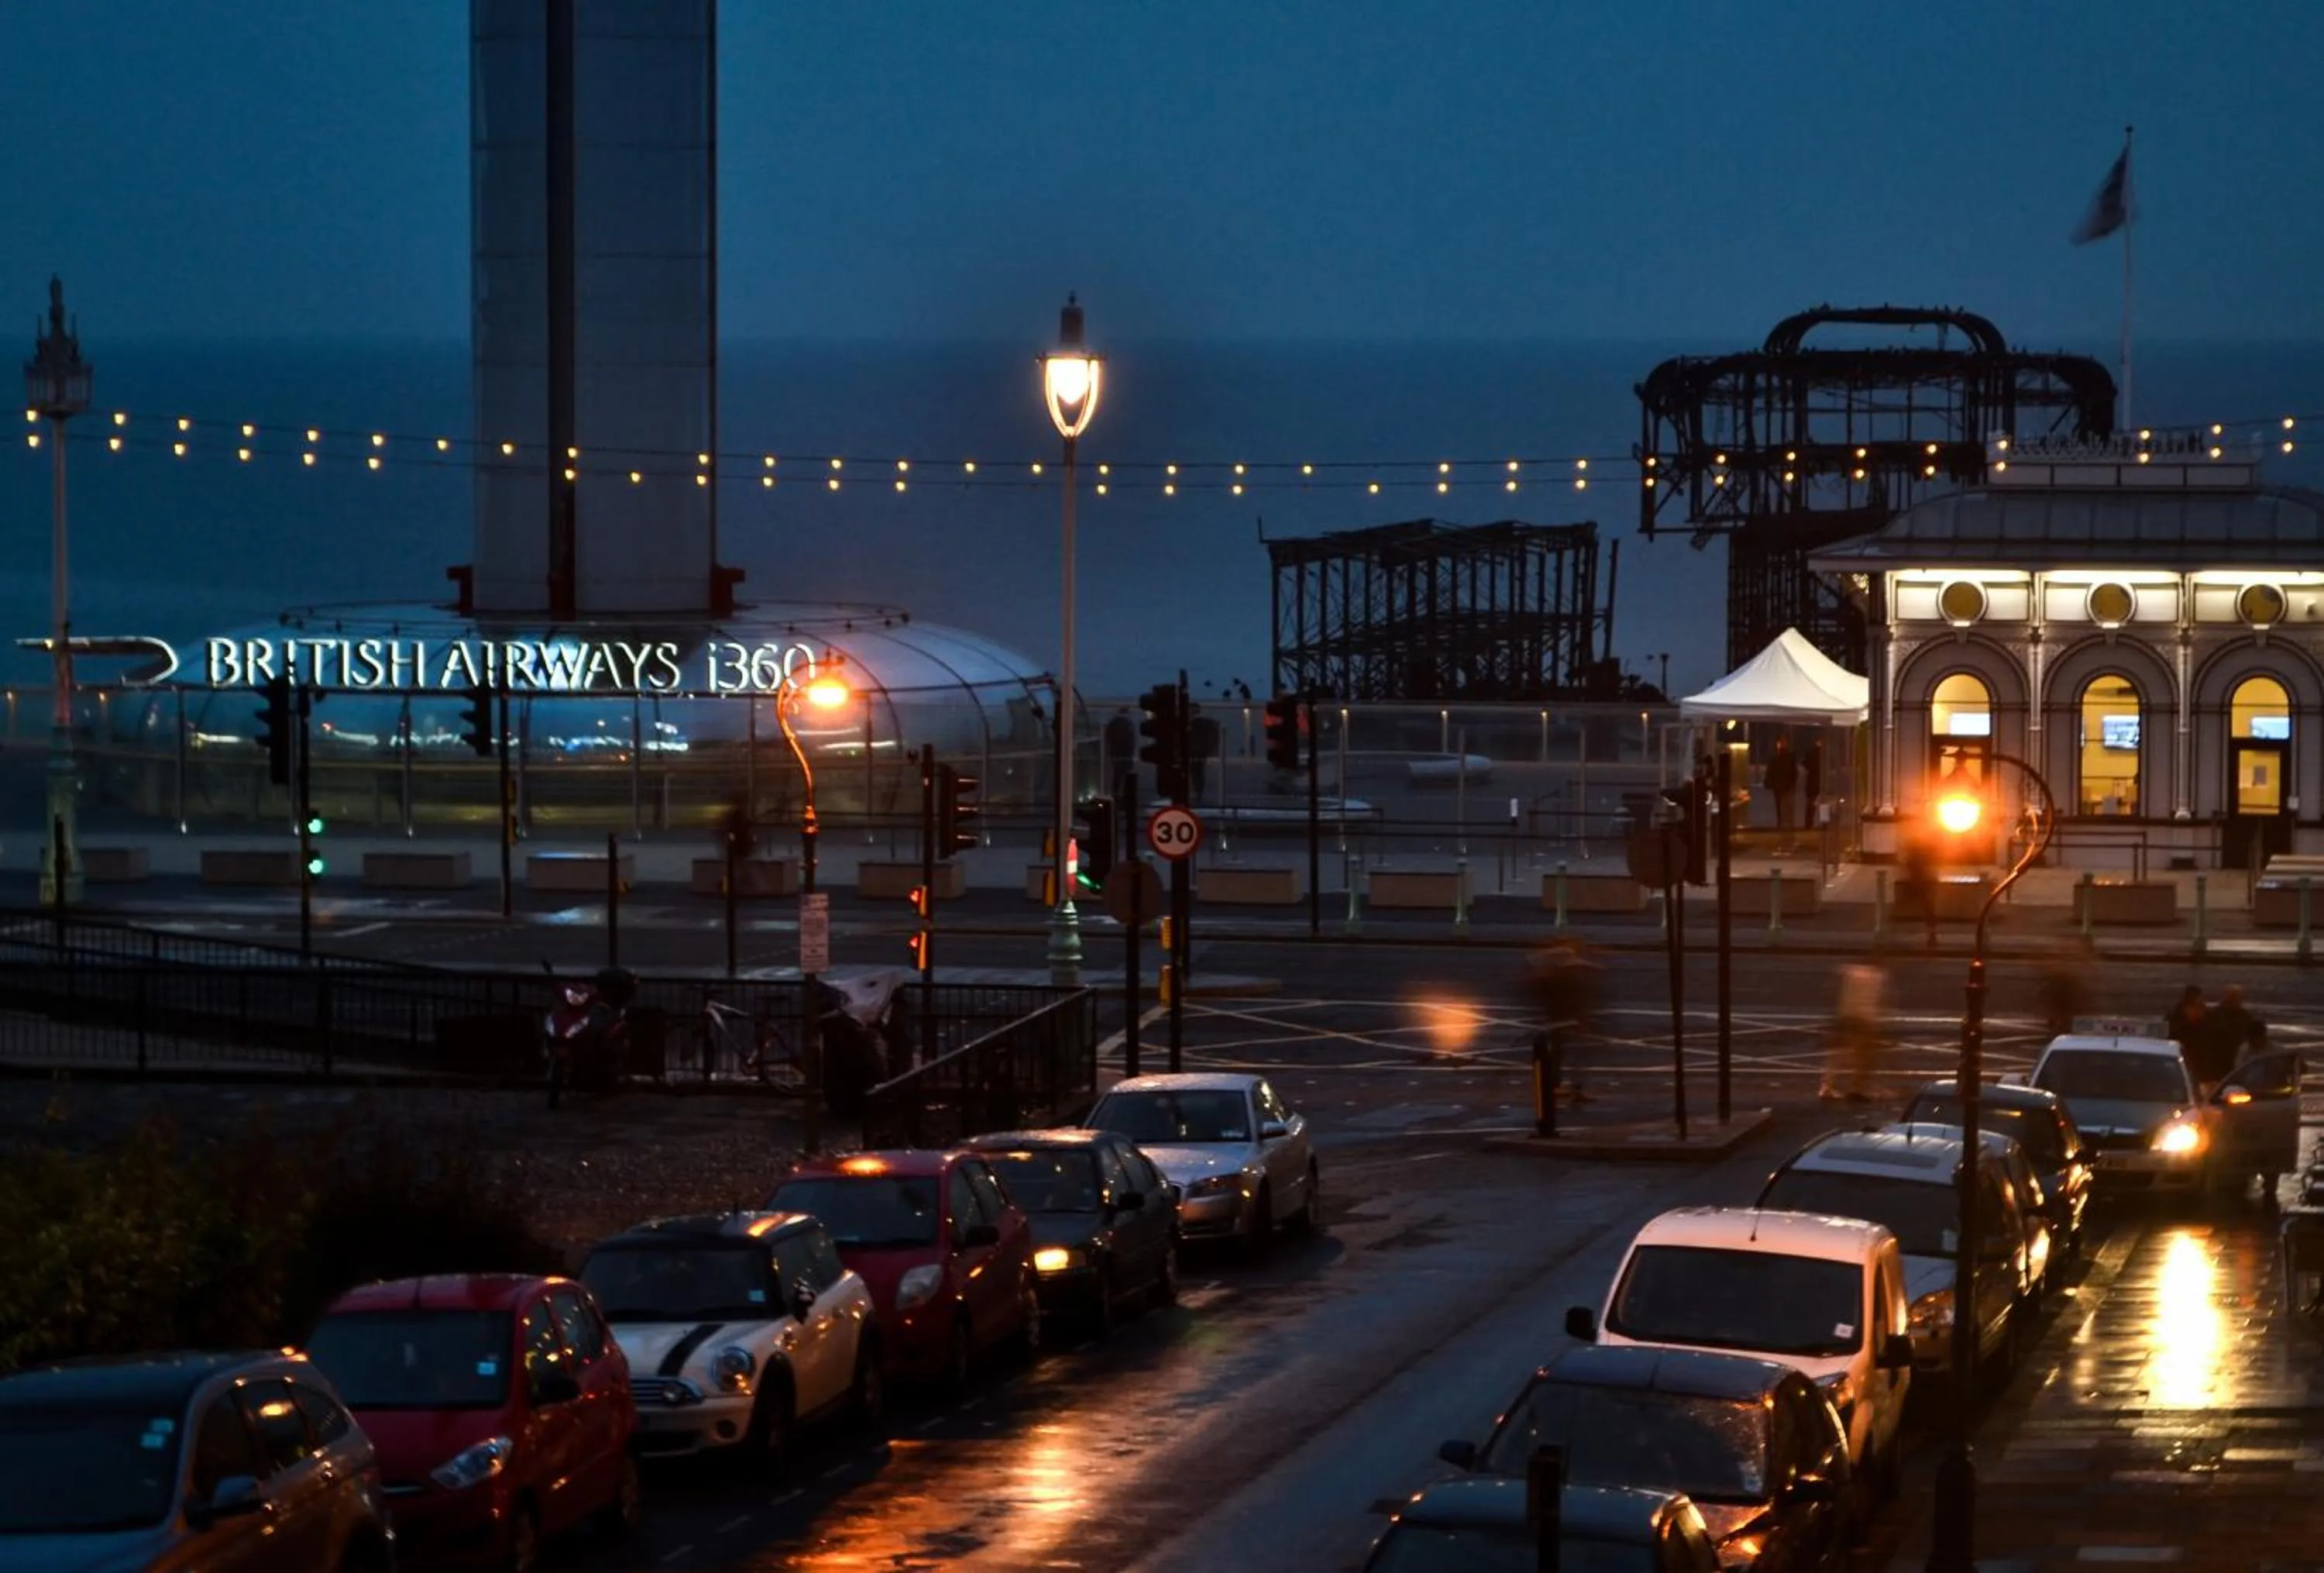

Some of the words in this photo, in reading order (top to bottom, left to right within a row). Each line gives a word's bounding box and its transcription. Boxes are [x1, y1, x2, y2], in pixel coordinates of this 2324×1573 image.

[205, 637, 425, 689] BRITISH
[440, 640, 682, 690] AIRWAYS
[1157, 821, 1194, 843] 30
